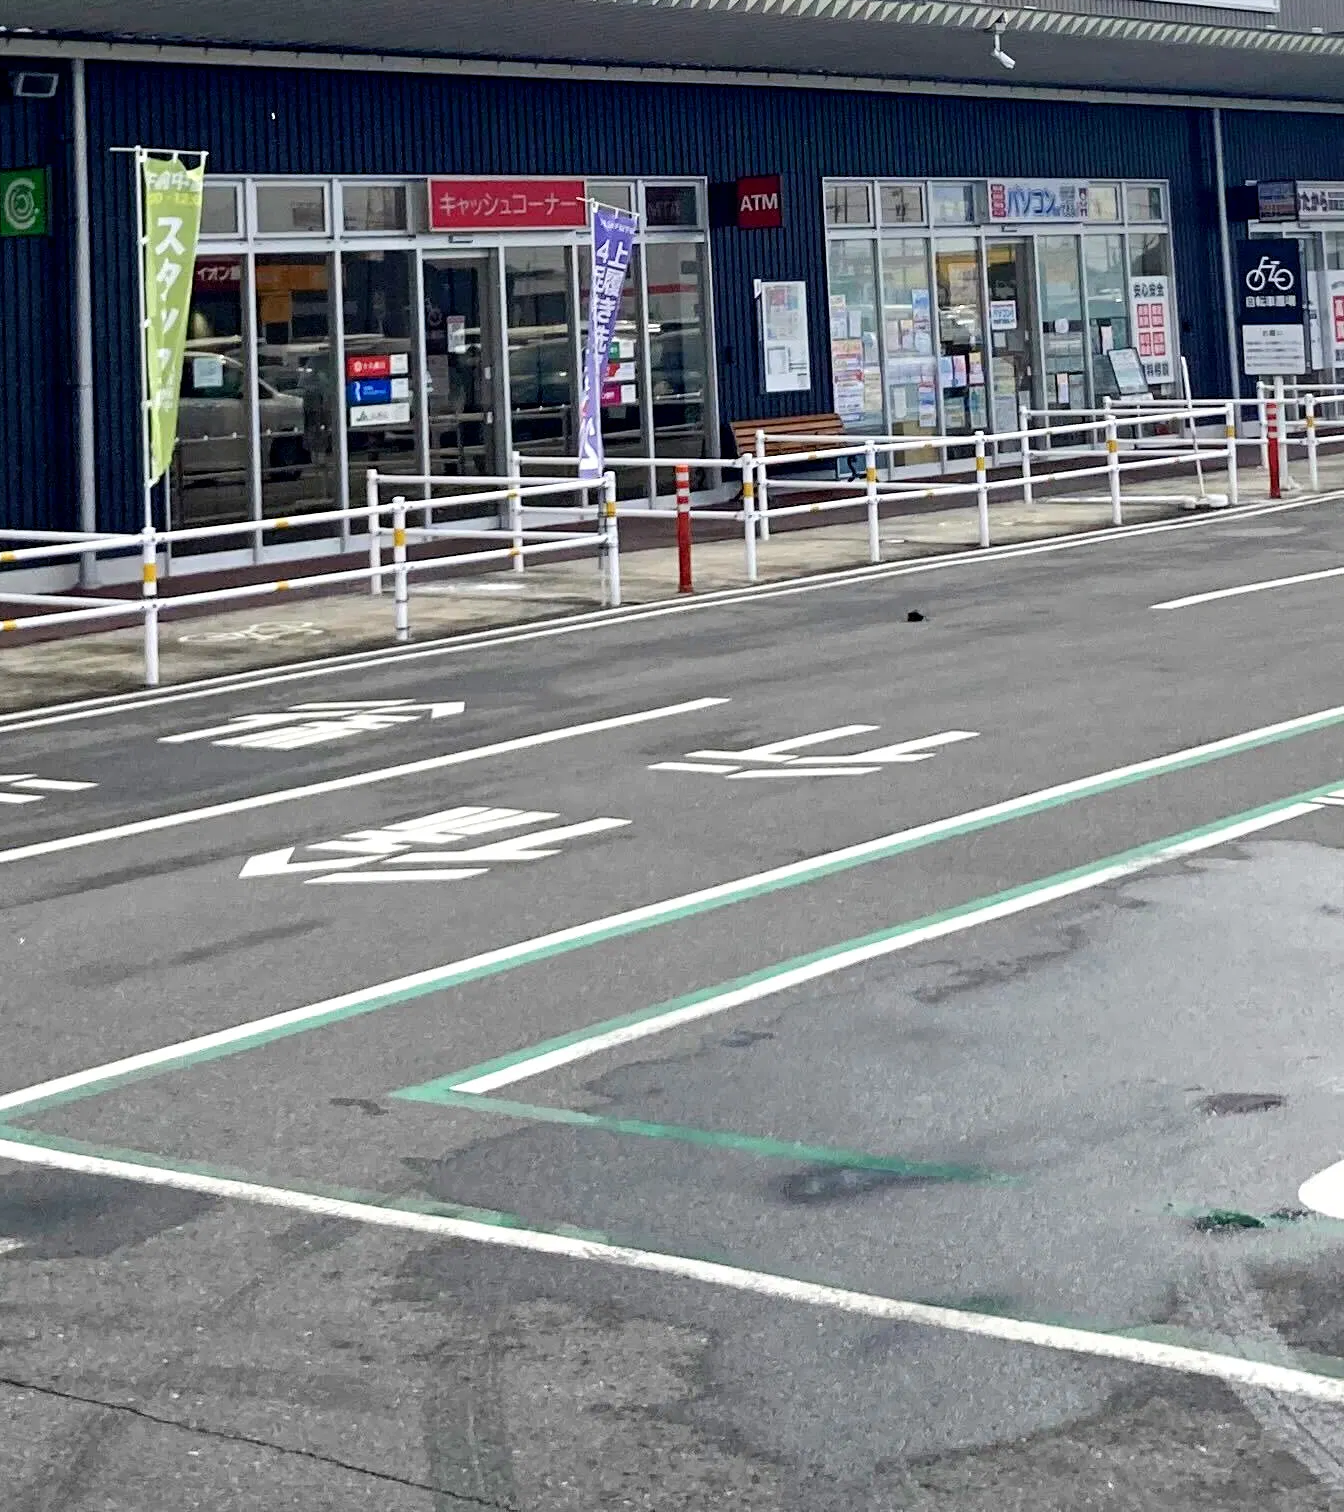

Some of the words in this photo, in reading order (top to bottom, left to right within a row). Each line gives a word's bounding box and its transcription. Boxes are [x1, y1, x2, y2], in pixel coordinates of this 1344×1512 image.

[439, 192, 577, 217] キャッシュコーナー
[739, 192, 780, 212] ATM
